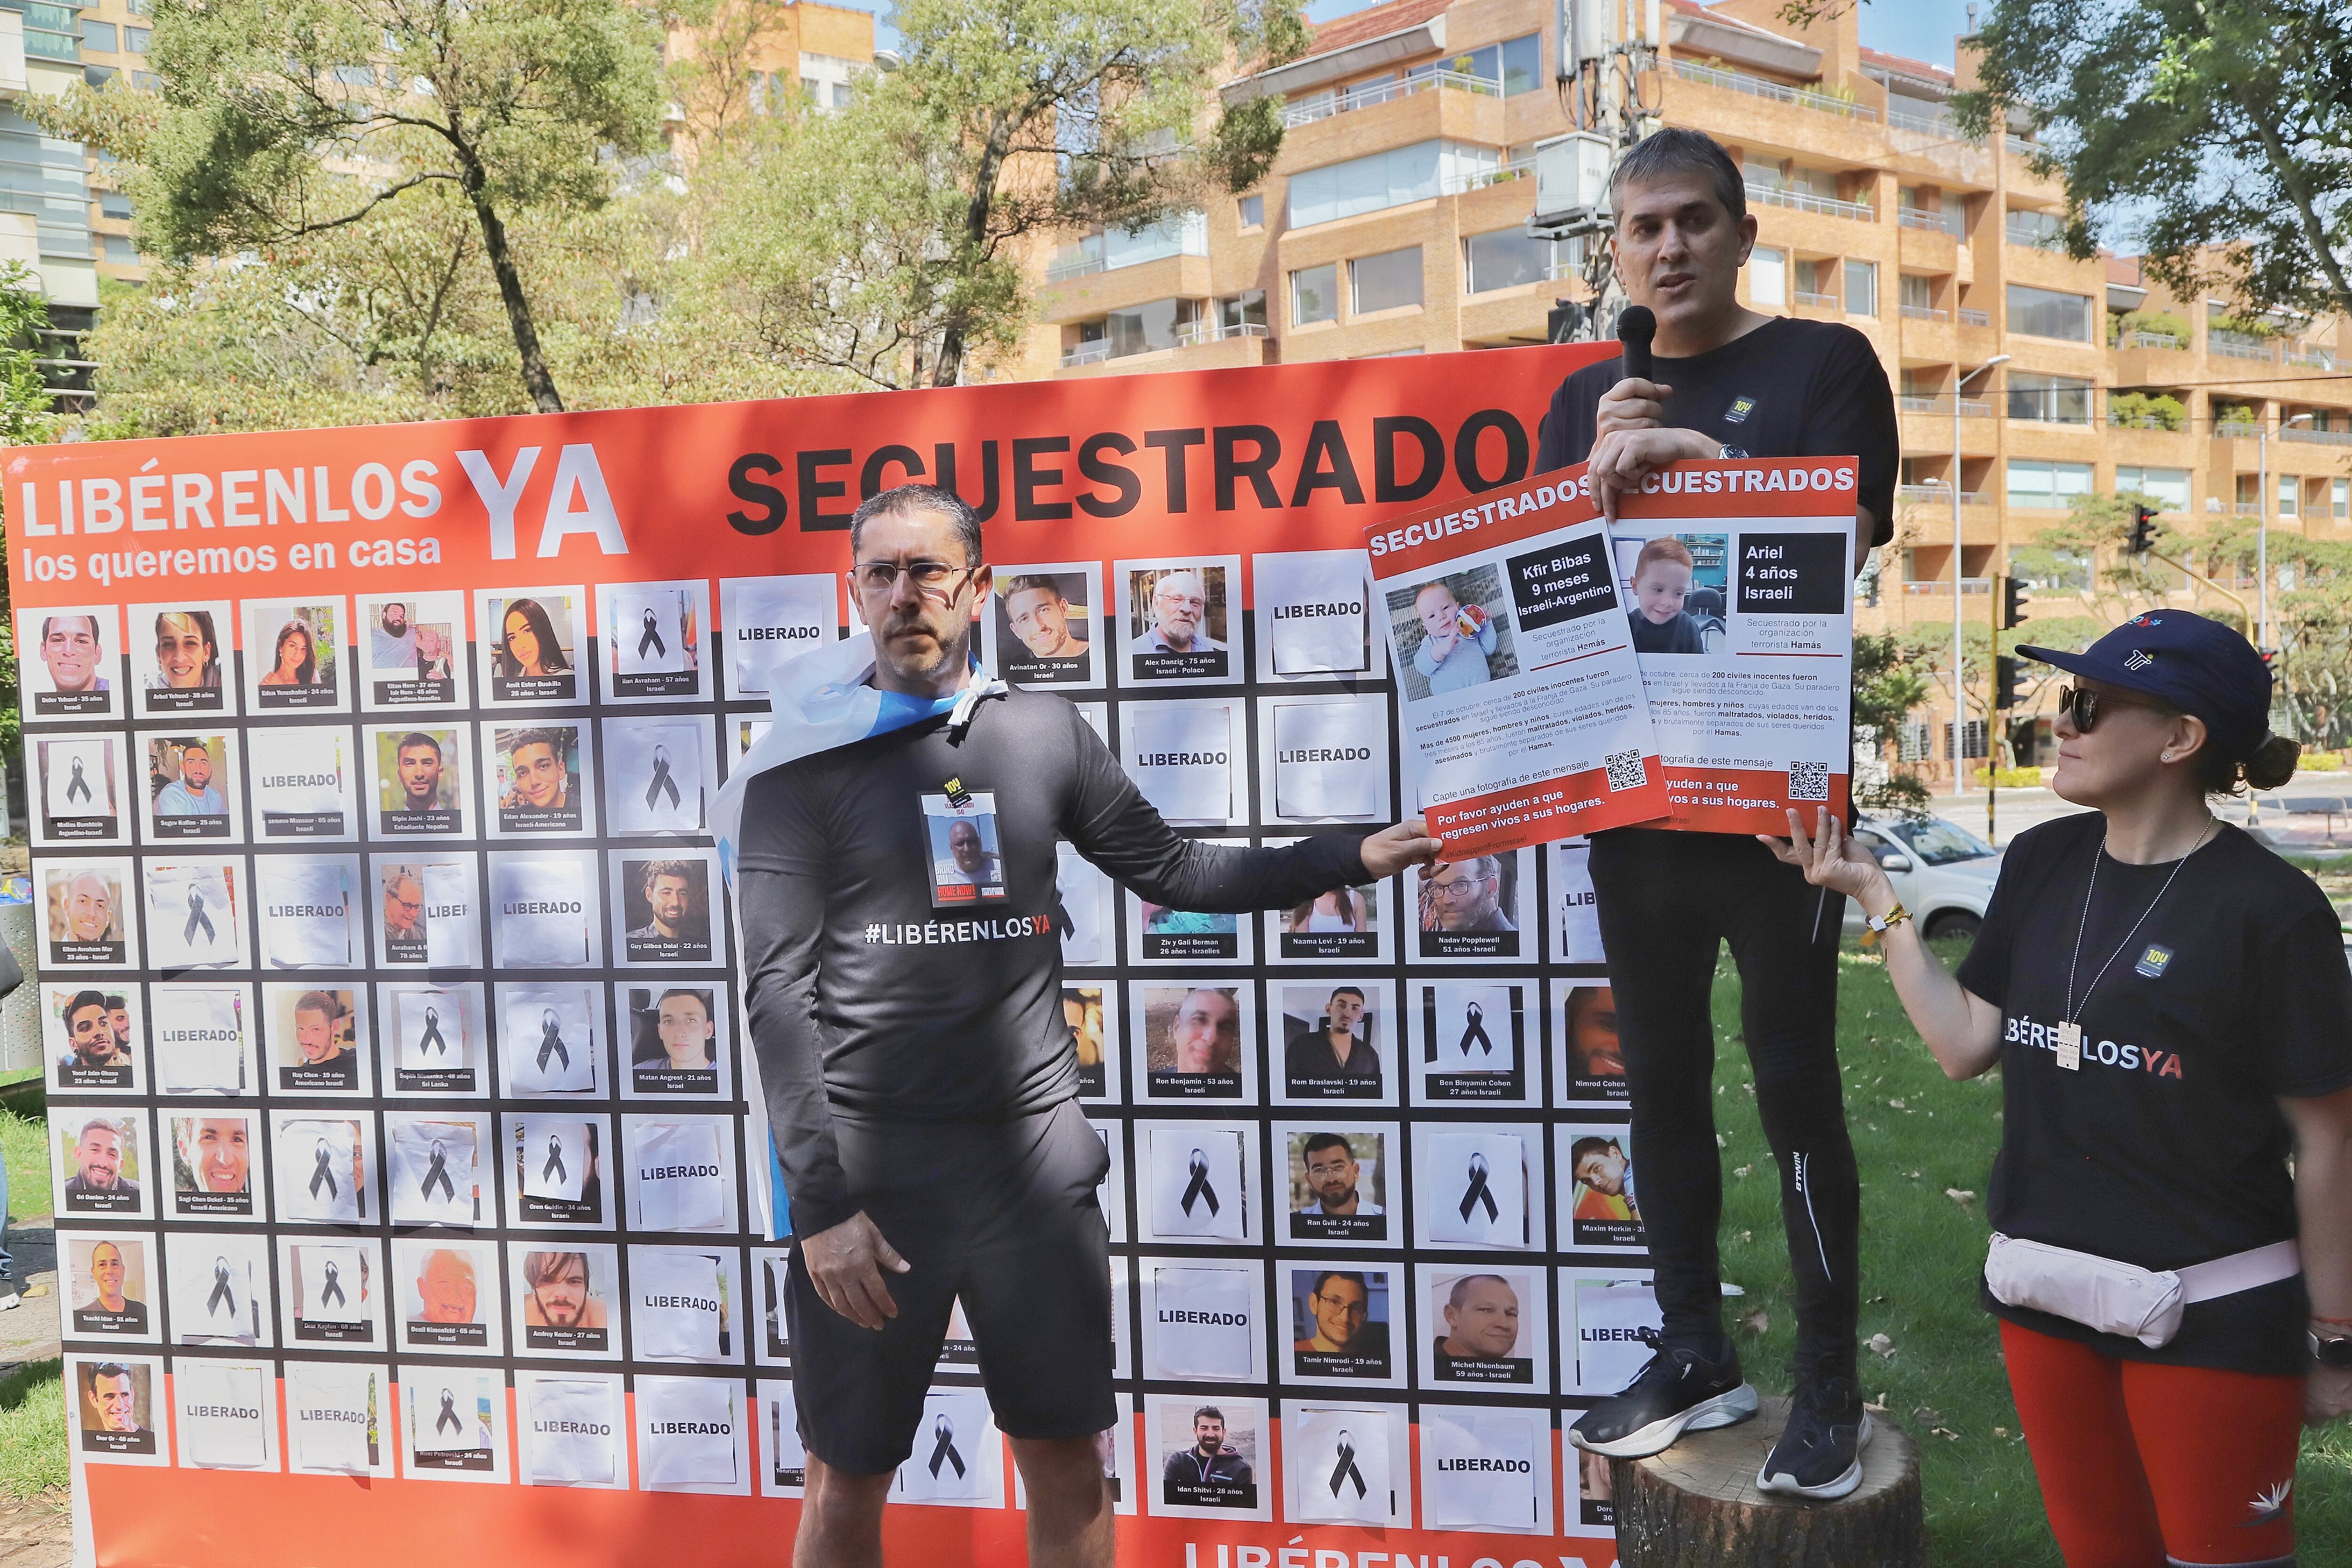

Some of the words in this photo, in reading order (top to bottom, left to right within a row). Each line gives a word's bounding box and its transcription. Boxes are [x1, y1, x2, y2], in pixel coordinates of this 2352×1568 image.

[726, 408, 1549, 536] SECUESTRADO
[1622, 468, 1854, 494] CUESTRADOS
[22, 457, 442, 537] LIBÉRENLOS
[454, 443, 629, 560] YA
[1370, 474, 1590, 556] SECUESTRADOS
[1746, 546, 1783, 559] Ariel
[23, 548, 77, 582] los
[88, 541, 278, 587] queremos
[289, 541, 335, 570] en
[349, 537, 441, 567] casa
[1522, 564, 1548, 580] Kfir
[1551, 554, 1591, 572] Bibas
[1746, 565, 1755, 579] 4
[1759, 566, 1798, 579] años
[1532, 583, 1541, 596] 9
[1544, 573, 1589, 593] meses
[1746, 586, 1793, 599] Israeli
[1518, 585, 1611, 616] Israeli-Argentino
[1274, 602, 1361, 619] LIBERADO
[1747, 618, 1800, 627] Secuestrado
[739, 626, 819, 640] LIBERADO
[1533, 624, 1581, 642] Secuestrado
[1583, 621, 1596, 630] por
[1546, 630, 1596, 648] organización
[1759, 629, 1813, 638] organización
[1541, 647, 1575, 661] terrorista
[1577, 639, 1605, 651] Hamás
[1455, 703, 1482, 713] octubre,
[1483, 698, 1502, 706] cerca
[1513, 690, 1525, 699] 200
[1527, 685, 1549, 695] civiles
[1550, 677, 1585, 689] inocentes
[1586, 670, 1610, 680] fueron
[1445, 735, 1461, 743] 4500
[1462, 729, 1491, 740] mujeres,
[1493, 721, 1523, 732] hombres
[1530, 715, 1551, 723] niños,
[1553, 709, 1573, 717] cuyas
[1574, 702, 1599, 712] edades
[1139, 752, 1227, 766] LIBERADO
[1279, 748, 1370, 763] LIBERADO
[1661, 755, 1694, 767] tografía
[1697, 756, 1708, 764] de
[1734, 758, 1773, 769] mensaje
[262, 774, 336, 788] LIBERADO
[1433, 791, 1457, 802] Capte
[1460, 787, 1476, 796] una
[1477, 776, 1518, 792] fotografía
[1519, 773, 1530, 782] de
[1532, 770, 1550, 779] este
[1553, 760, 1589, 774] mensaje
[1667, 779, 1702, 793] yuden
[1716, 782, 1739, 793] que
[1437, 815, 1457, 826] Por
[1459, 808, 1487, 821] favor
[1490, 799, 1530, 815] ayuden
[1542, 791, 1563, 804] que
[1669, 795, 1688, 805] vos
[1702, 797, 1724, 805] sus
[1727, 796, 1779, 809] hogares.
[1441, 823, 1488, 840] regresen
[1490, 816, 1520, 828] vivos
[1533, 808, 1553, 819] sus
[1555, 797, 1605, 814] hogares.
[1446, 835, 1527, 860] #KidnappedFromIsrael
[935, 864, 955, 875] BRING
[936, 875, 949, 885] HIM
[938, 885, 956, 897] HOME
[957, 884, 976, 896] NOW!
[269, 905, 344, 917] LIBERADO
[503, 902, 581, 915] LIBERADO
[864, 914, 1051, 945] #LIBÉRENLOSYA
[163, 1029, 237, 1042] LIBERADO
[641, 1165, 719, 1180] LIBERADO
[645, 1295, 717, 1312] LIBERADO
[1159, 1310, 1247, 1326] LIBERADO
[1581, 1329, 1660, 1341] LIBER
[188, 1405, 259, 1419] LIBERADO
[300, 1409, 366, 1425] LIBERADO
[534, 1421, 611, 1436] LIBERADO
[651, 1423, 731, 1435] LIBERADO
[1438, 1459, 1530, 1473] LIBERADO
